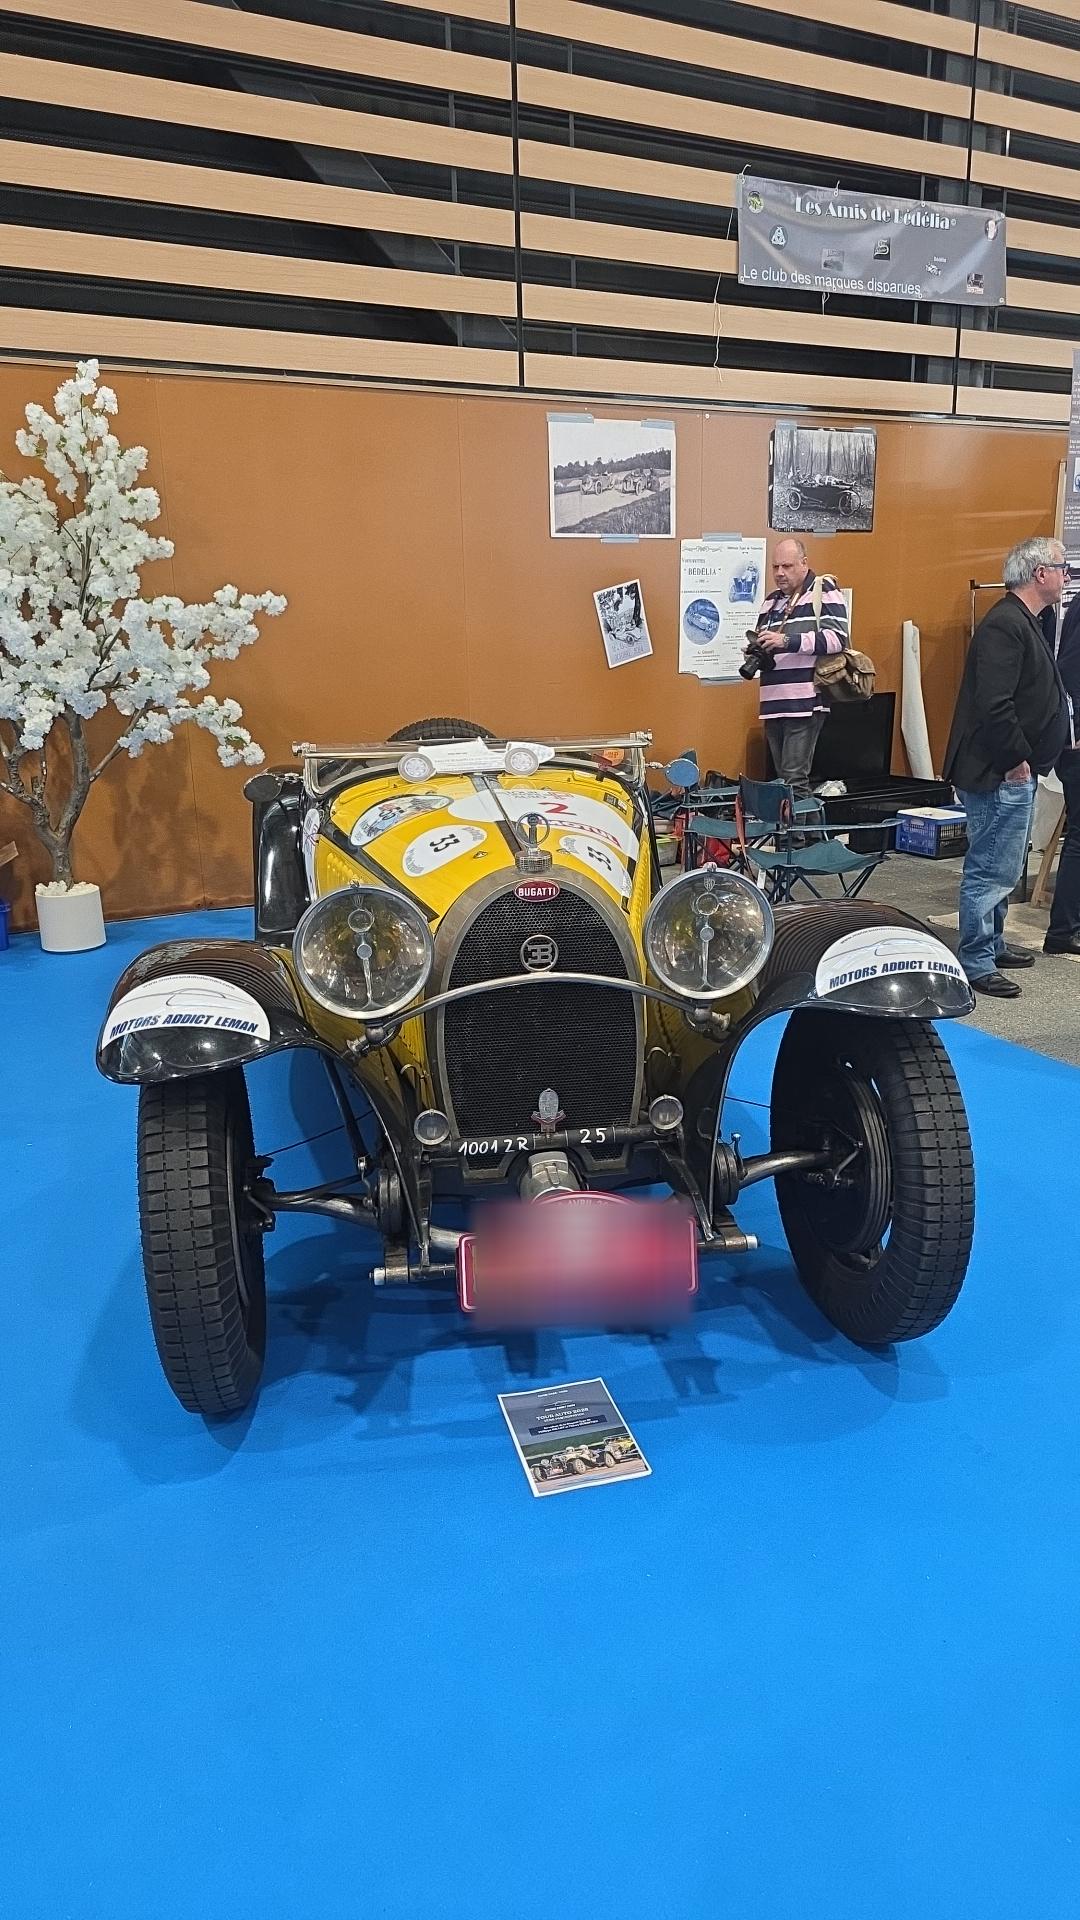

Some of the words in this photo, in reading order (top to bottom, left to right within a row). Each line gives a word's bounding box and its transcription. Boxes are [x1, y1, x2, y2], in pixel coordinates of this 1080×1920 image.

[795, 197, 822, 215] Les
[825, 202, 868, 220] Amis
[870, 206, 891, 222] de
[743, 264, 758, 279] Le
[762, 267, 787, 282] club
[791, 270, 811, 284] des
[815, 275, 863, 291] marques
[868, 278, 921, 295] disparues
[538, 802, 577, 816] 2
[429, 834, 460, 853] 33
[518, 887, 556, 897] BUGATTI
[829, 965, 878, 990] MOTORS
[881, 960, 925, 974] ADDICT
[927, 961, 960, 977] LEMAN
[109, 1015, 161, 1039] MOTORS
[162, 1013, 215, 1025] ADDICT
[214, 1016, 259, 1033] LEMAN
[579, 1127, 608, 1143] 25
